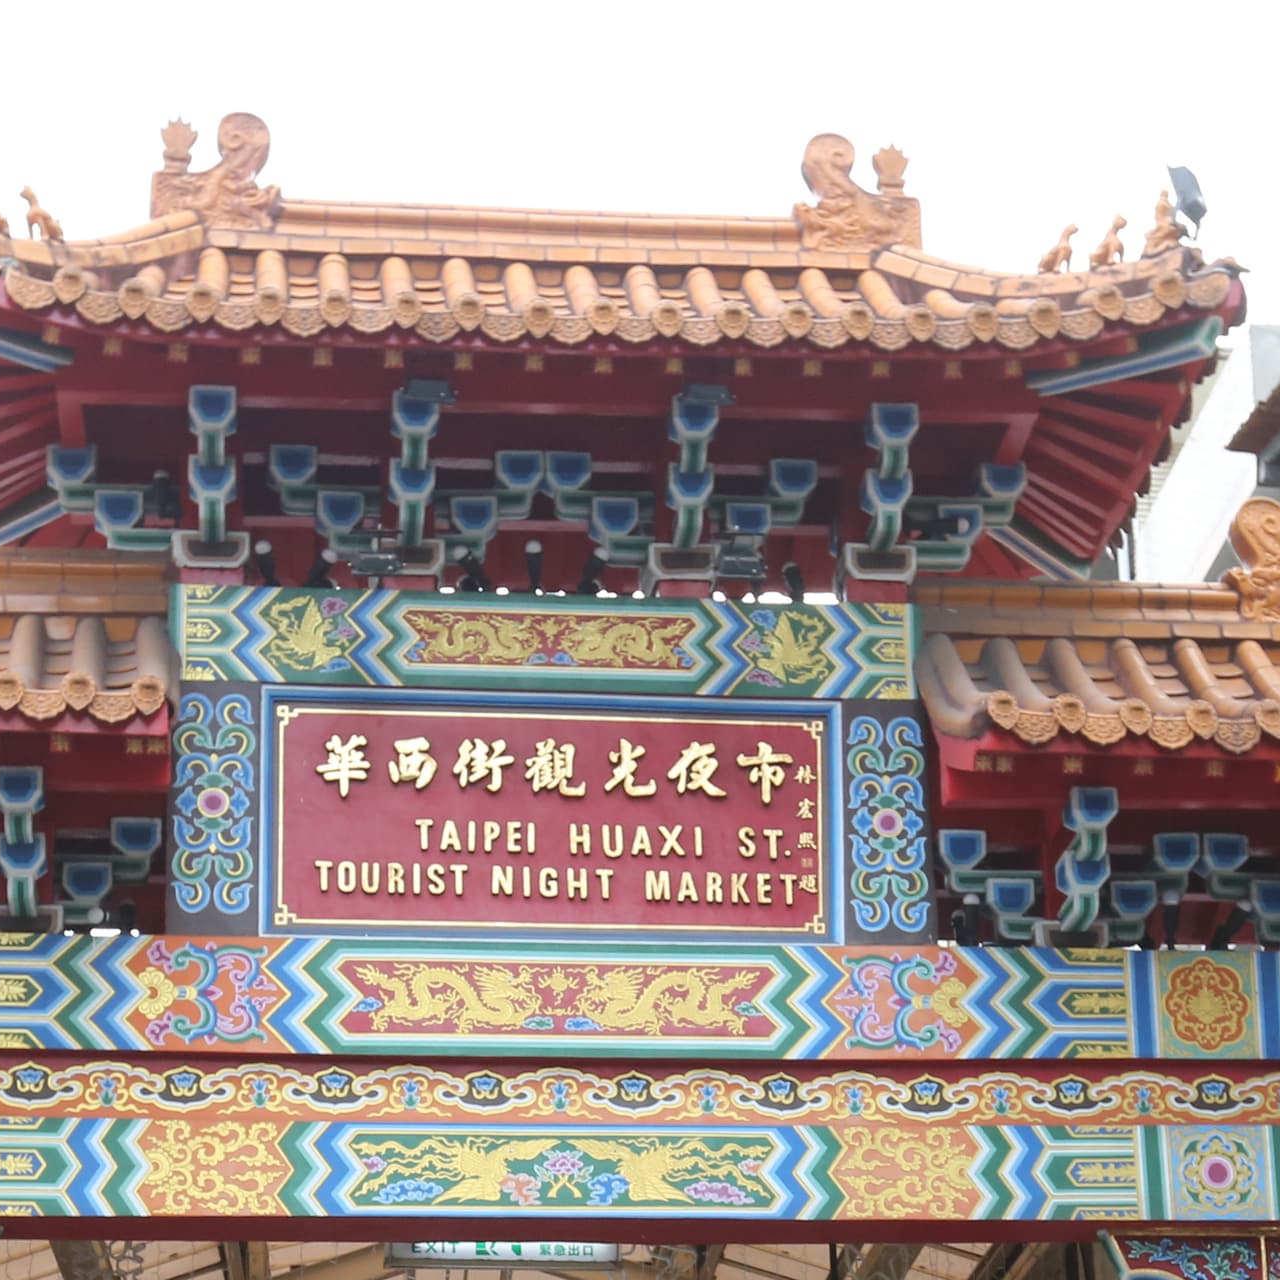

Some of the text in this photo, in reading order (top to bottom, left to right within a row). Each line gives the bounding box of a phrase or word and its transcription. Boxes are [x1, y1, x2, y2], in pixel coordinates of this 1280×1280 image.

[317, 735, 791, 803] 華西街觀光夜市
[415, 818, 792, 861] TAIPEI HUAXI ST.
[315, 859, 799, 907] TOURIST NIGHT MARKET
[411, 1241, 460, 1254] EXIT
[539, 1244, 594, 1257] 緊急出口
